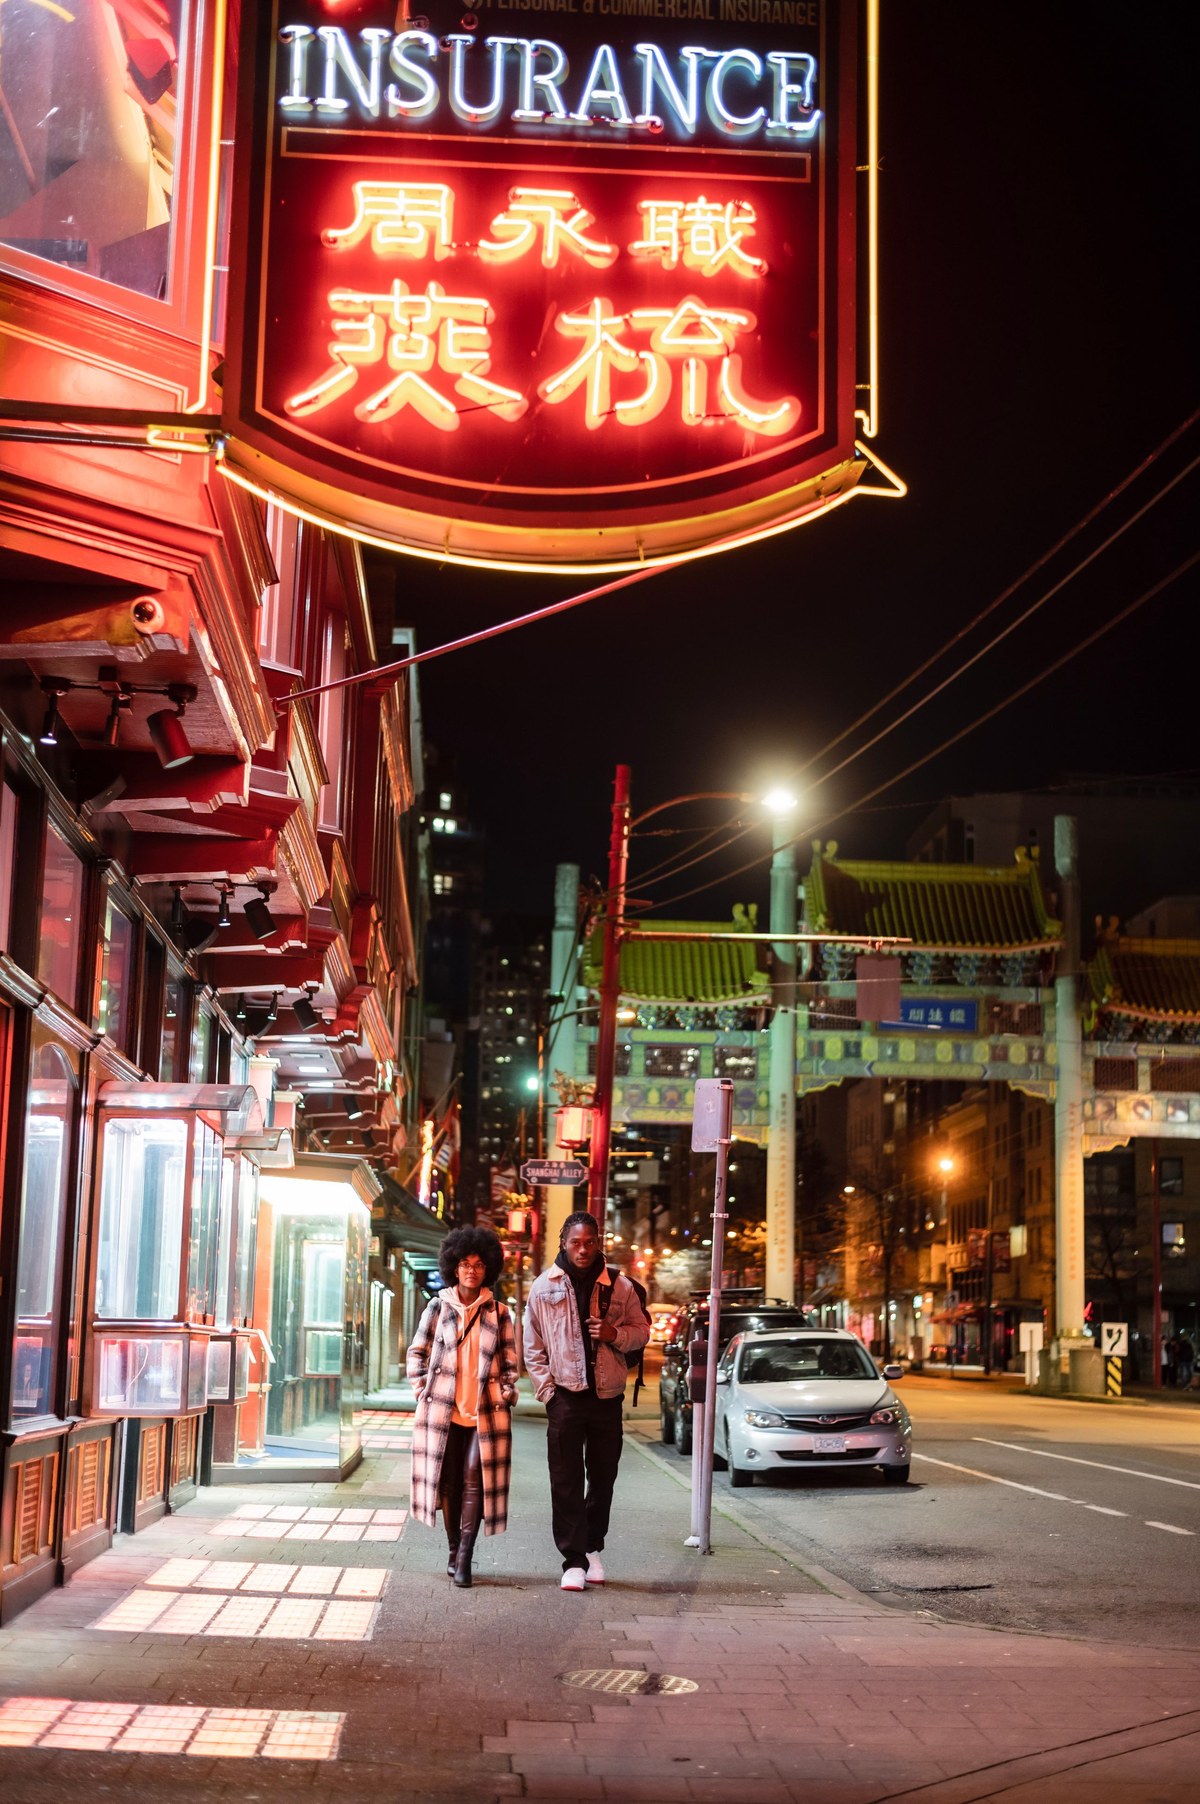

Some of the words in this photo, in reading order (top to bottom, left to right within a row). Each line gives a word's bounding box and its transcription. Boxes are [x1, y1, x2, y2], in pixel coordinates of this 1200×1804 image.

[599, 0, 714, 20] COMMERCIAL
[719, 0, 817, 26] INSURANCE
[281, 25, 822, 137] INSURANCE
[526, 1168, 560, 1177] SHANGHAI
[562, 1168, 582, 1178] ALLEY
